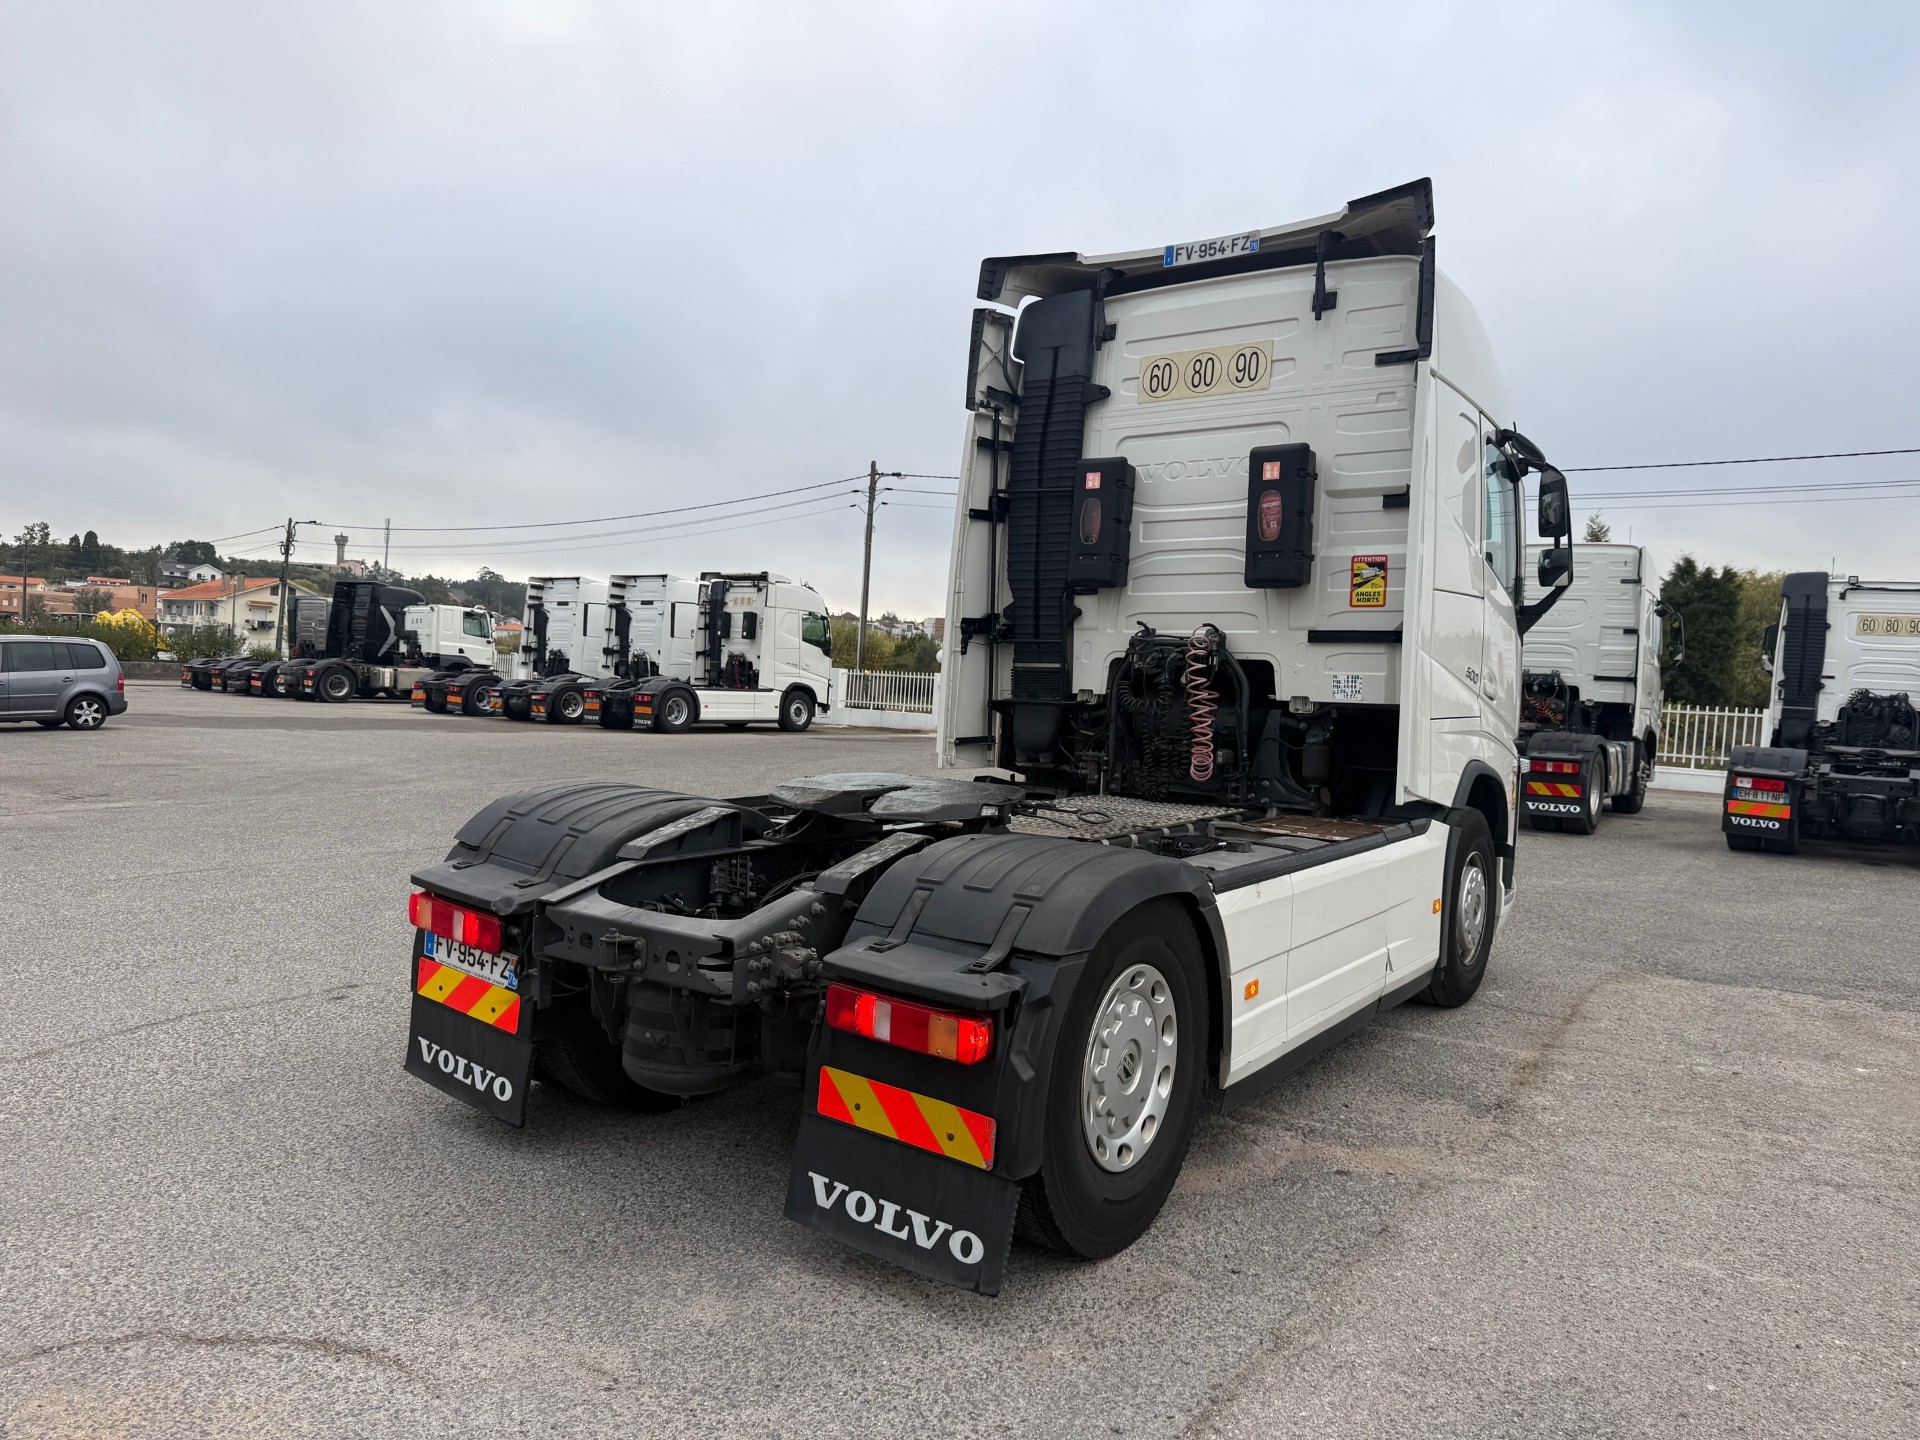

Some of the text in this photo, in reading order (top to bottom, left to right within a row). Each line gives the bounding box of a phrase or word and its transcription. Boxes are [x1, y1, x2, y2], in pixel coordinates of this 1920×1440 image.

[1175, 235, 1250, 263] FV-954-FZ
[1149, 351, 1259, 393] 60 80 90
[1863, 618, 1876, 632] 60
[1885, 619, 1899, 633] 80
[1526, 801, 1581, 813] VOLVO
[1730, 815, 1780, 829] VOLVO
[418, 1035, 513, 1102] VOLVO
[808, 1171, 985, 1264] VOLVO
